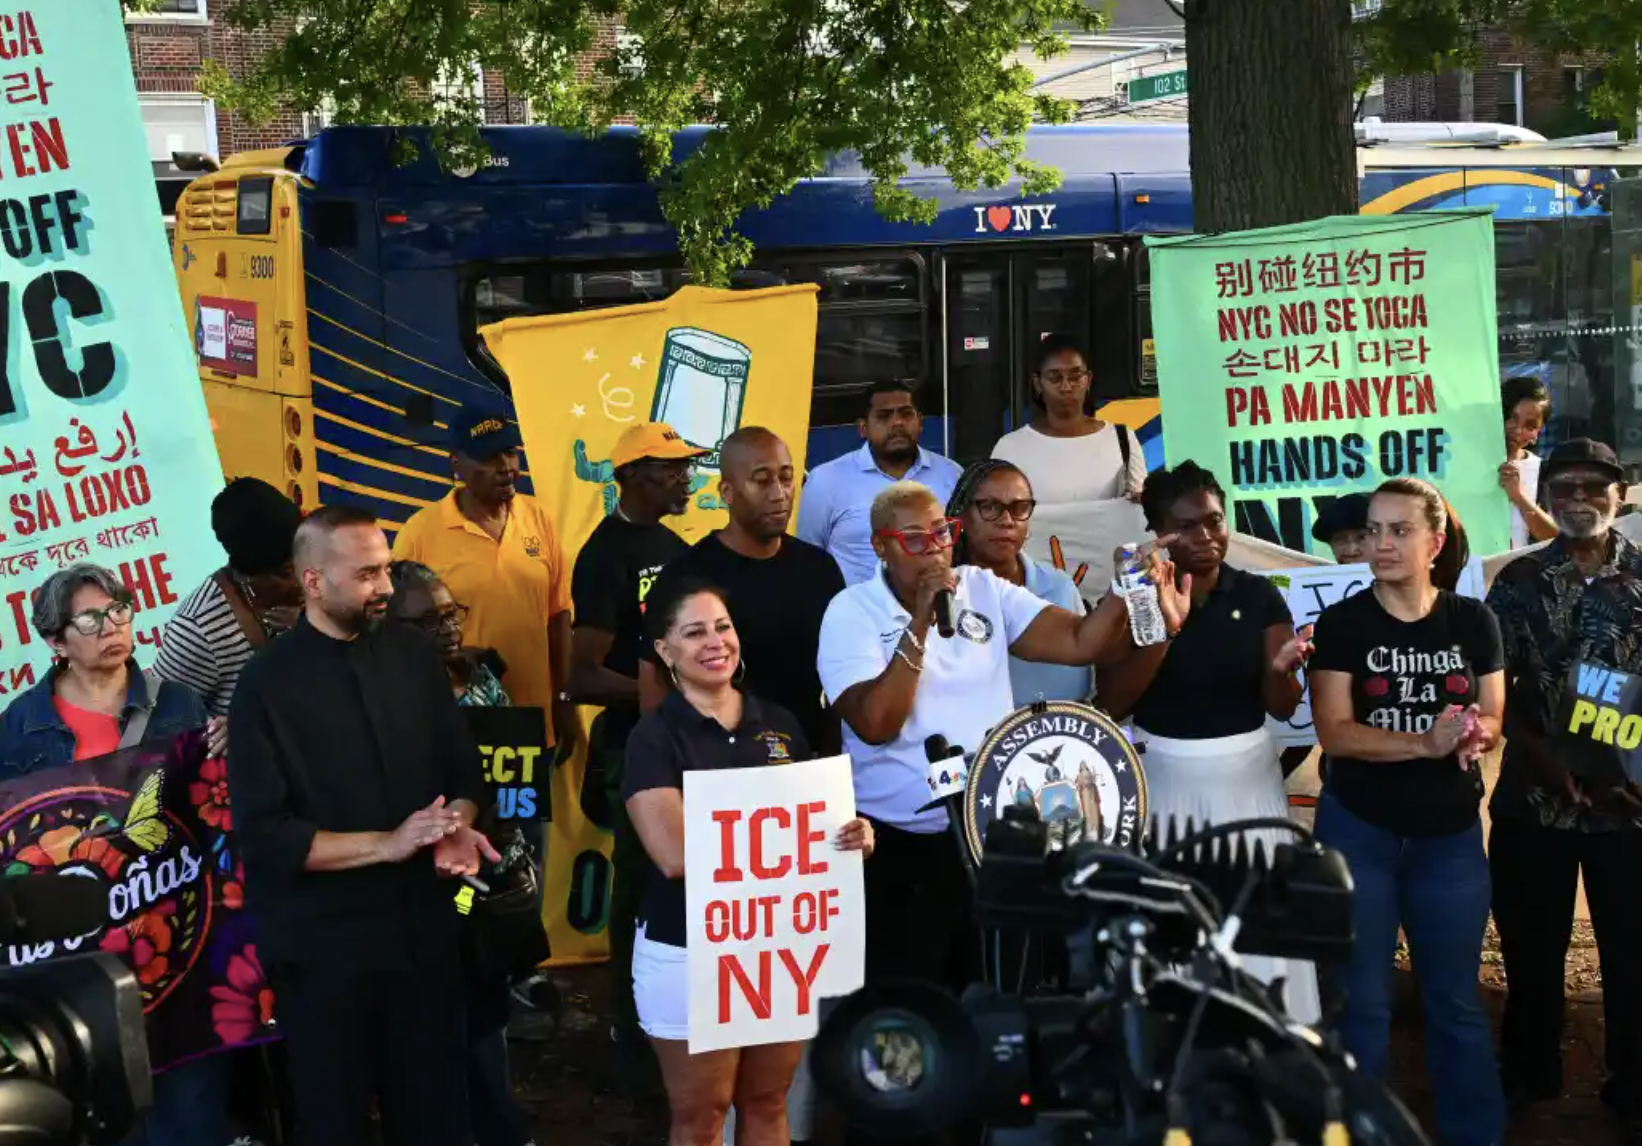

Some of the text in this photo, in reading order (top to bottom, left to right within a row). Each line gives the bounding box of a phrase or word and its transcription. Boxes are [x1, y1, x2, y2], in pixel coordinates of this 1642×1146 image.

[1154, 75, 1185, 94] 102 St
[0, 189, 94, 258] OFF
[974, 204, 1056, 232] I NY
[250, 255, 274, 279] 9300
[1215, 247, 1427, 298] 别碰纽约市
[1218, 294, 1428, 342] NYC NO SE TOCA
[1222, 335, 1431, 377] 손대지 마라
[1225, 375, 1437, 427] PA MANYEN
[1230, 428, 1444, 485] HANDS OFF
[9, 465, 150, 535] SA LOXO
[1396, 677, 1437, 703] La
[1577, 663, 1628, 704] WE
[993, 716, 1108, 771] ASSEMBLY
[1568, 699, 1642, 749] PRO
[939, 770, 951, 784] 4
[497, 787, 537, 818] US
[712, 801, 829, 883] ICE
[108, 845, 202, 920] oñas
[705, 889, 839, 943] OUT OF
[717, 944, 830, 1023] NY
